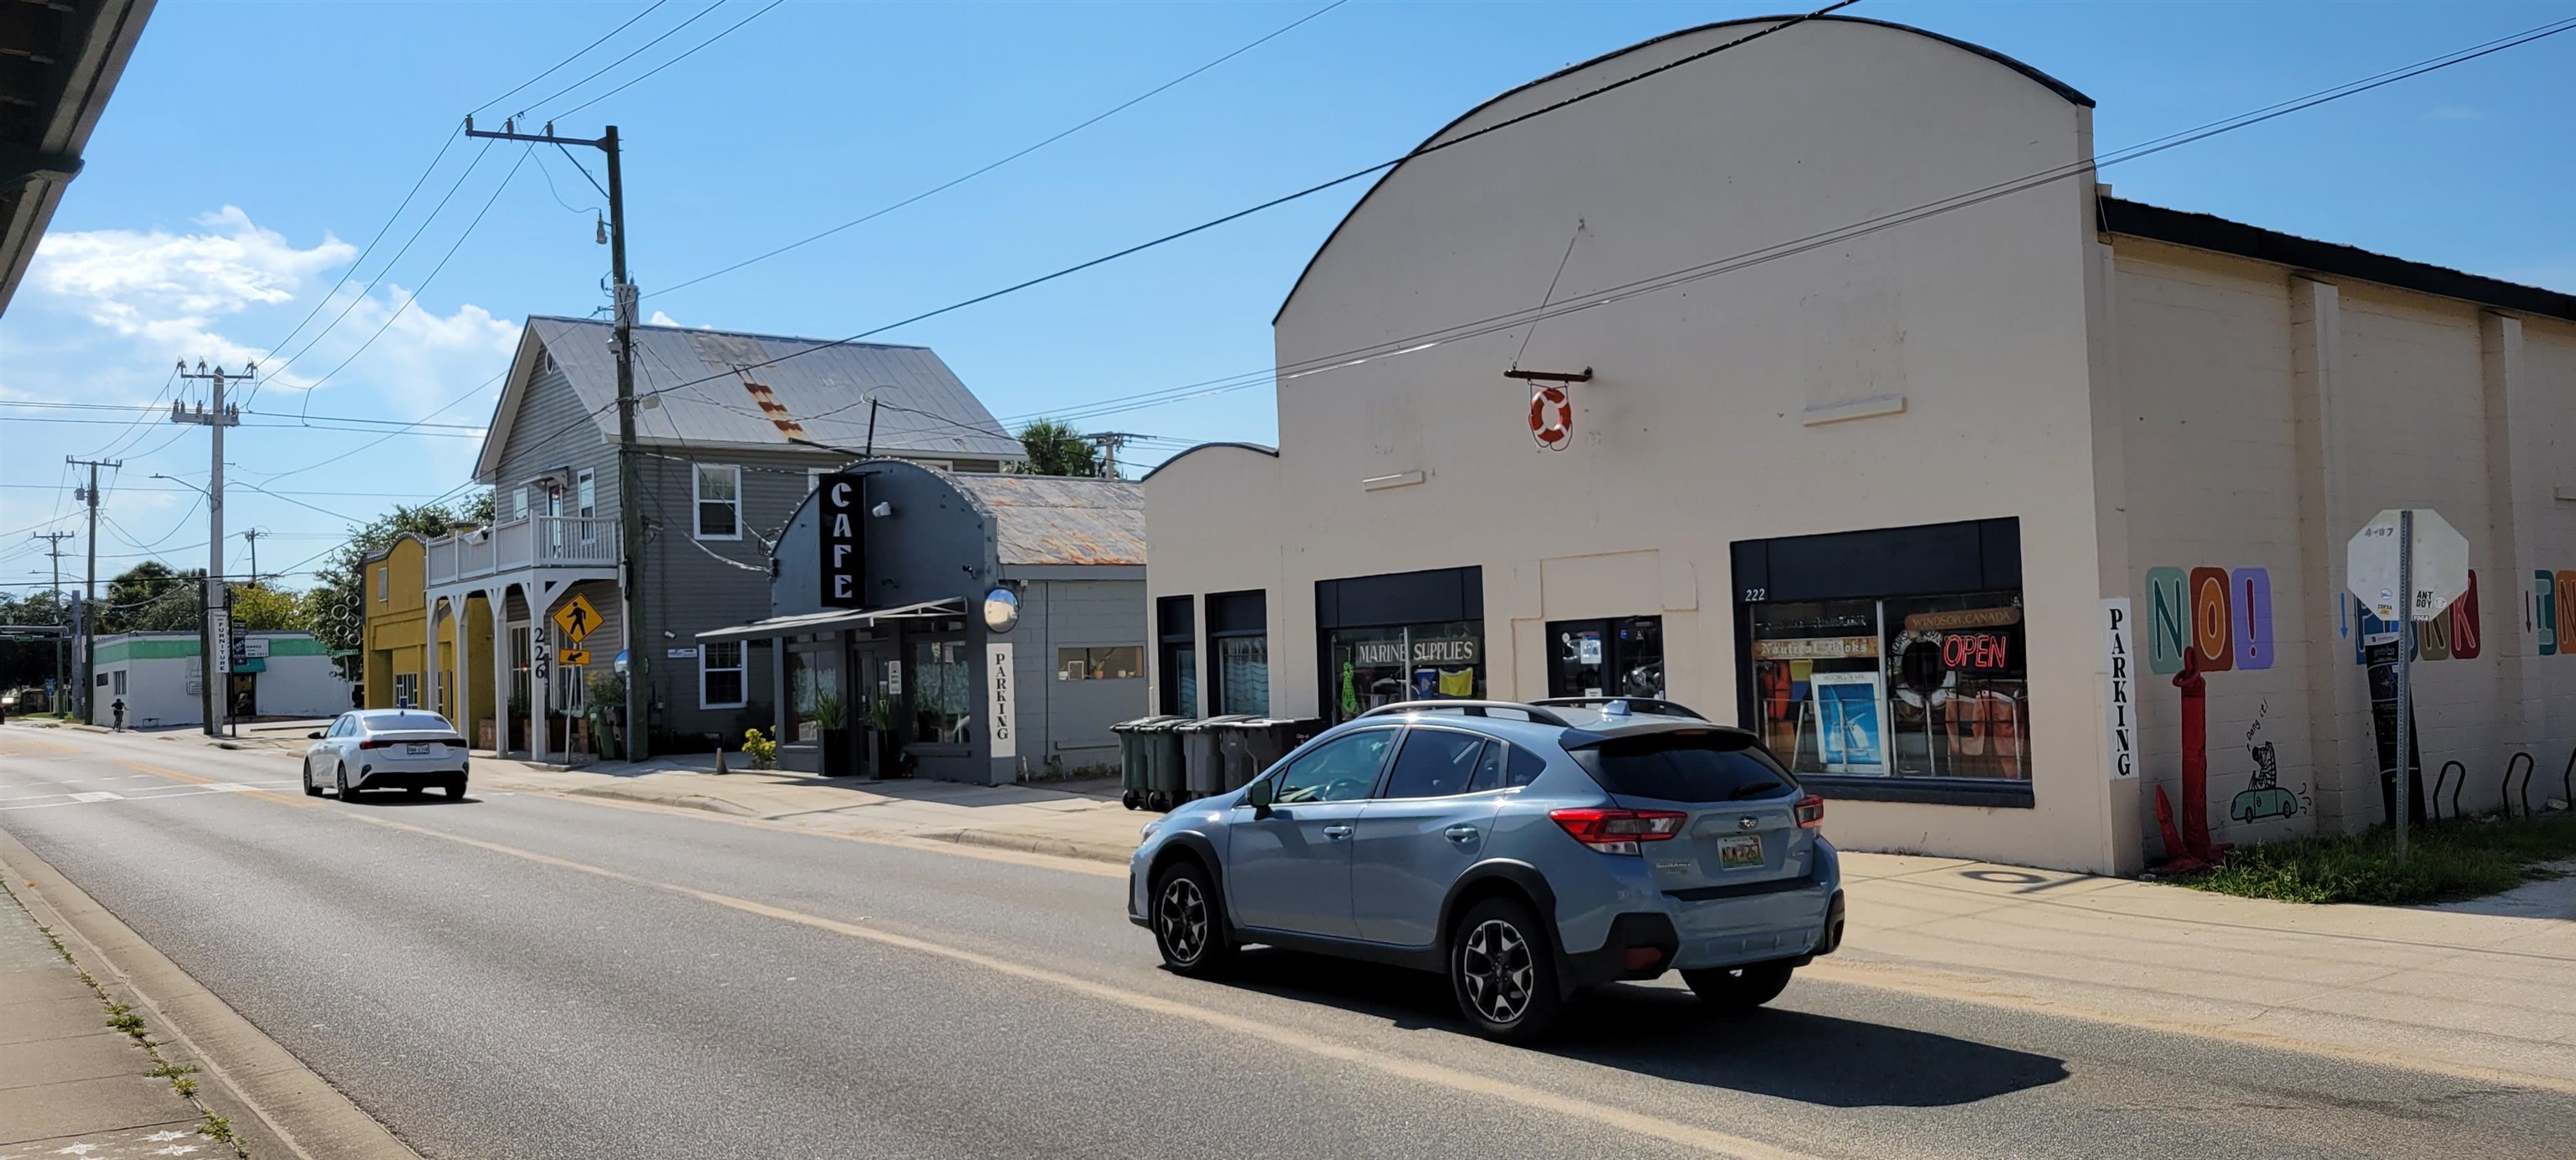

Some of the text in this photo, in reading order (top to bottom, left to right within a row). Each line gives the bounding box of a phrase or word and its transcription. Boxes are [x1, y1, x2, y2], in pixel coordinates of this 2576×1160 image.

[831, 482, 852, 598] CAFE
[1745, 588, 1765, 601] 222
[2153, 576, 2257, 661] NO!
[2417, 590, 2434, 600] ANT
[218, 622, 226, 671] FURNITURE
[534, 627, 545, 679] 226
[1358, 641, 1474, 663] MARINE SUPPLIES
[1944, 633, 2007, 668] OPEN
[995, 653, 1009, 740] PARKING
[2109, 608, 2132, 777] PARKING
[2246, 718, 2262, 741] Dang
